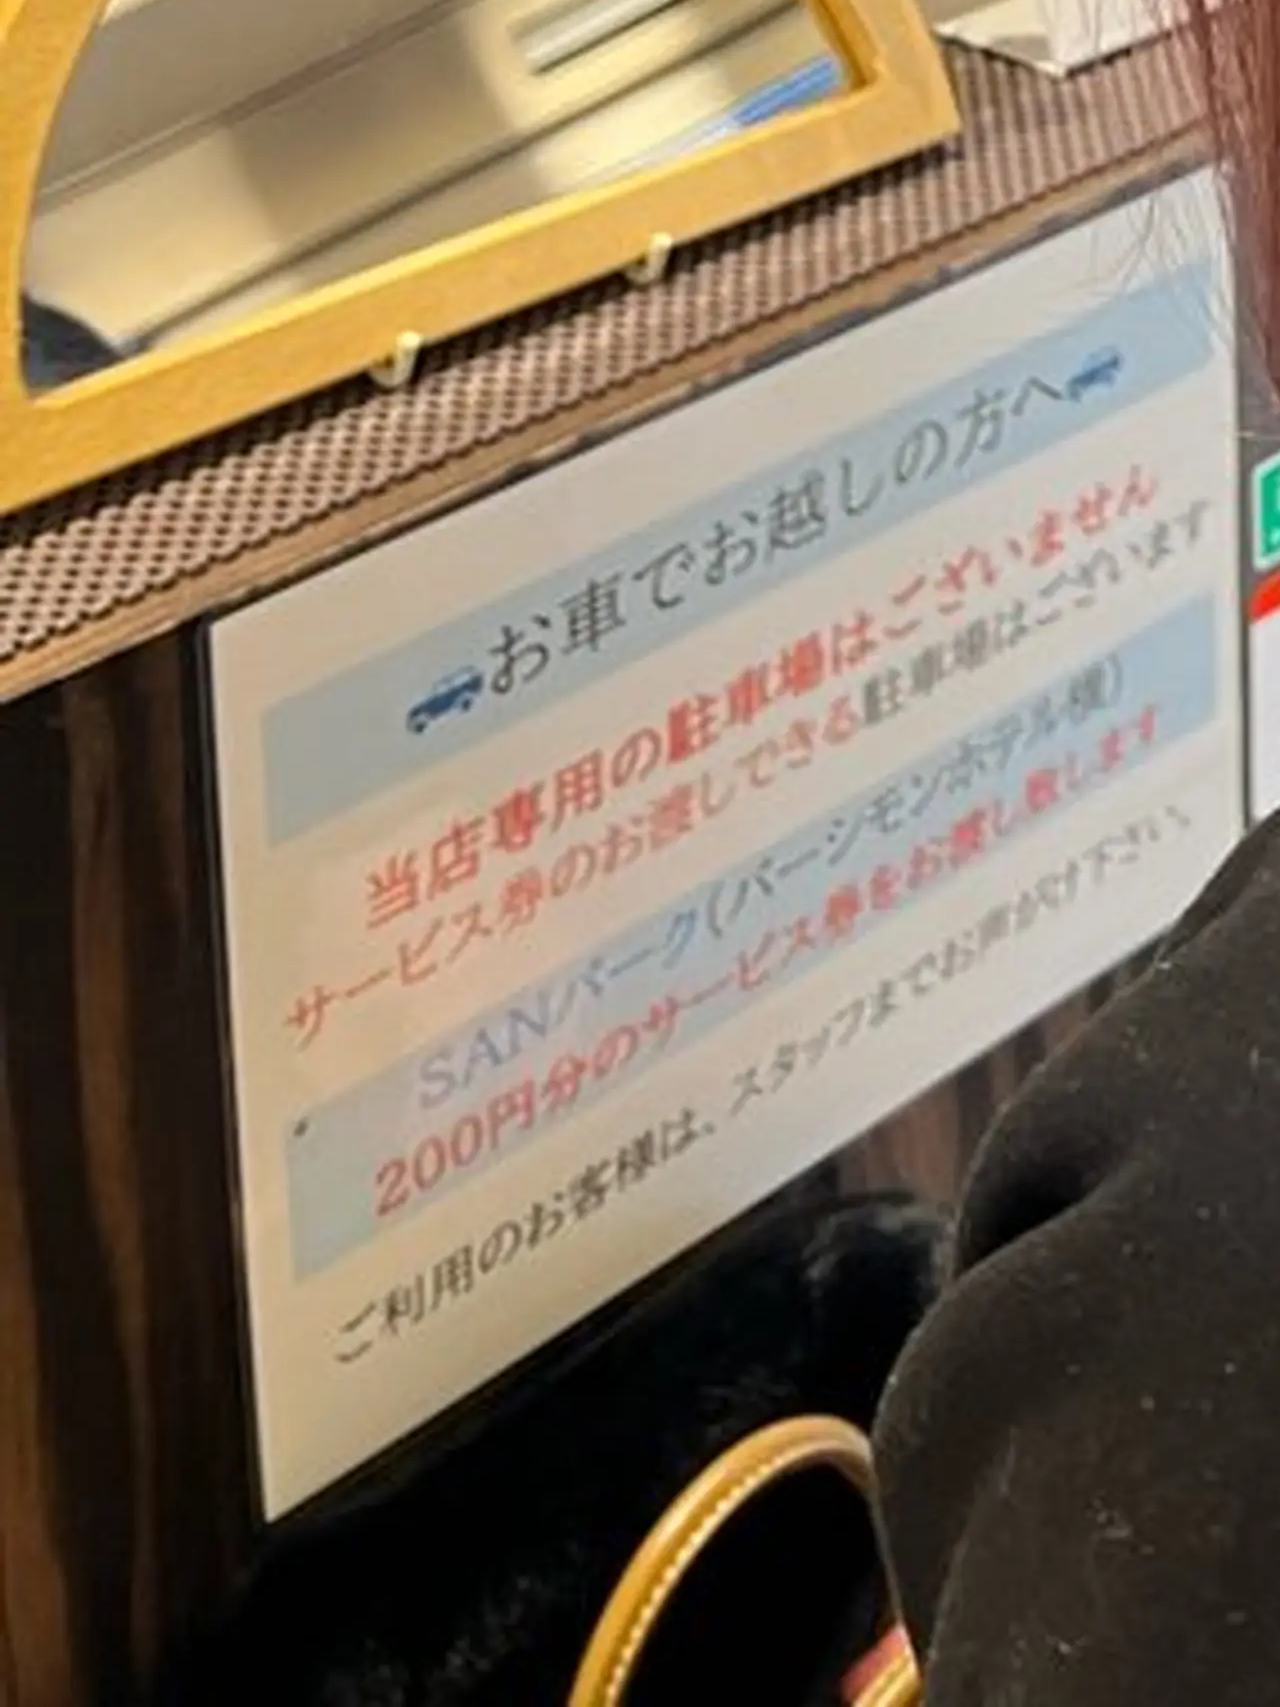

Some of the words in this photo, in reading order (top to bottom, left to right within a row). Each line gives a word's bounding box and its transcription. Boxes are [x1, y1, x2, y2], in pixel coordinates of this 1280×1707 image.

[283, 498, 1210, 1051] サービス券のお渡しできる駐車場はございます
[366, 465, 1159, 928] 当店専用の駐車場はございません
[486, 374, 1067, 695] お車でお越しの方へ
[374, 702, 1159, 1218] 200円分のサービス券をお渡し致します
